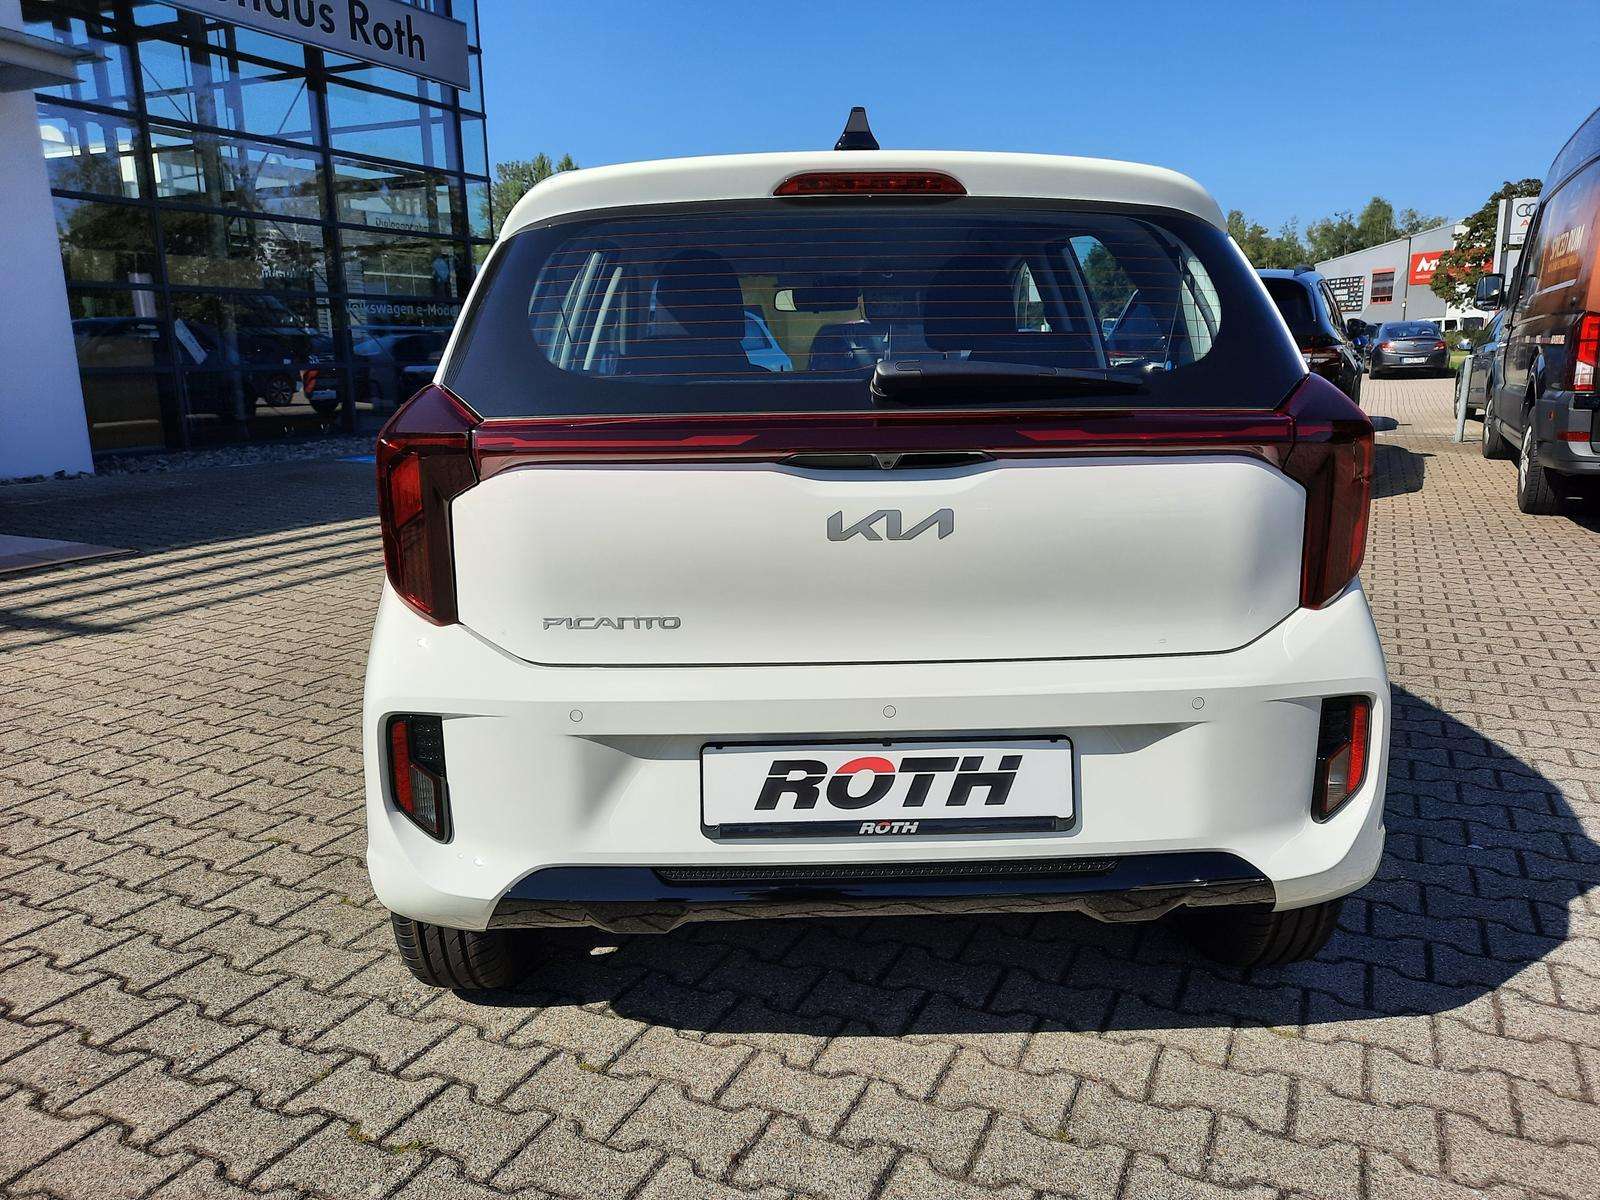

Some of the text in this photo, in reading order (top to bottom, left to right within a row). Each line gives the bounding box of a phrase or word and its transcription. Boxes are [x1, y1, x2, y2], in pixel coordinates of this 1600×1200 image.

[216, 0, 426, 62] aus Roth
[827, 508, 954, 541] KIA
[543, 616, 682, 630] PICANTO
[754, 755, 1023, 810] ROTH
[859, 821, 920, 835] ROTH
